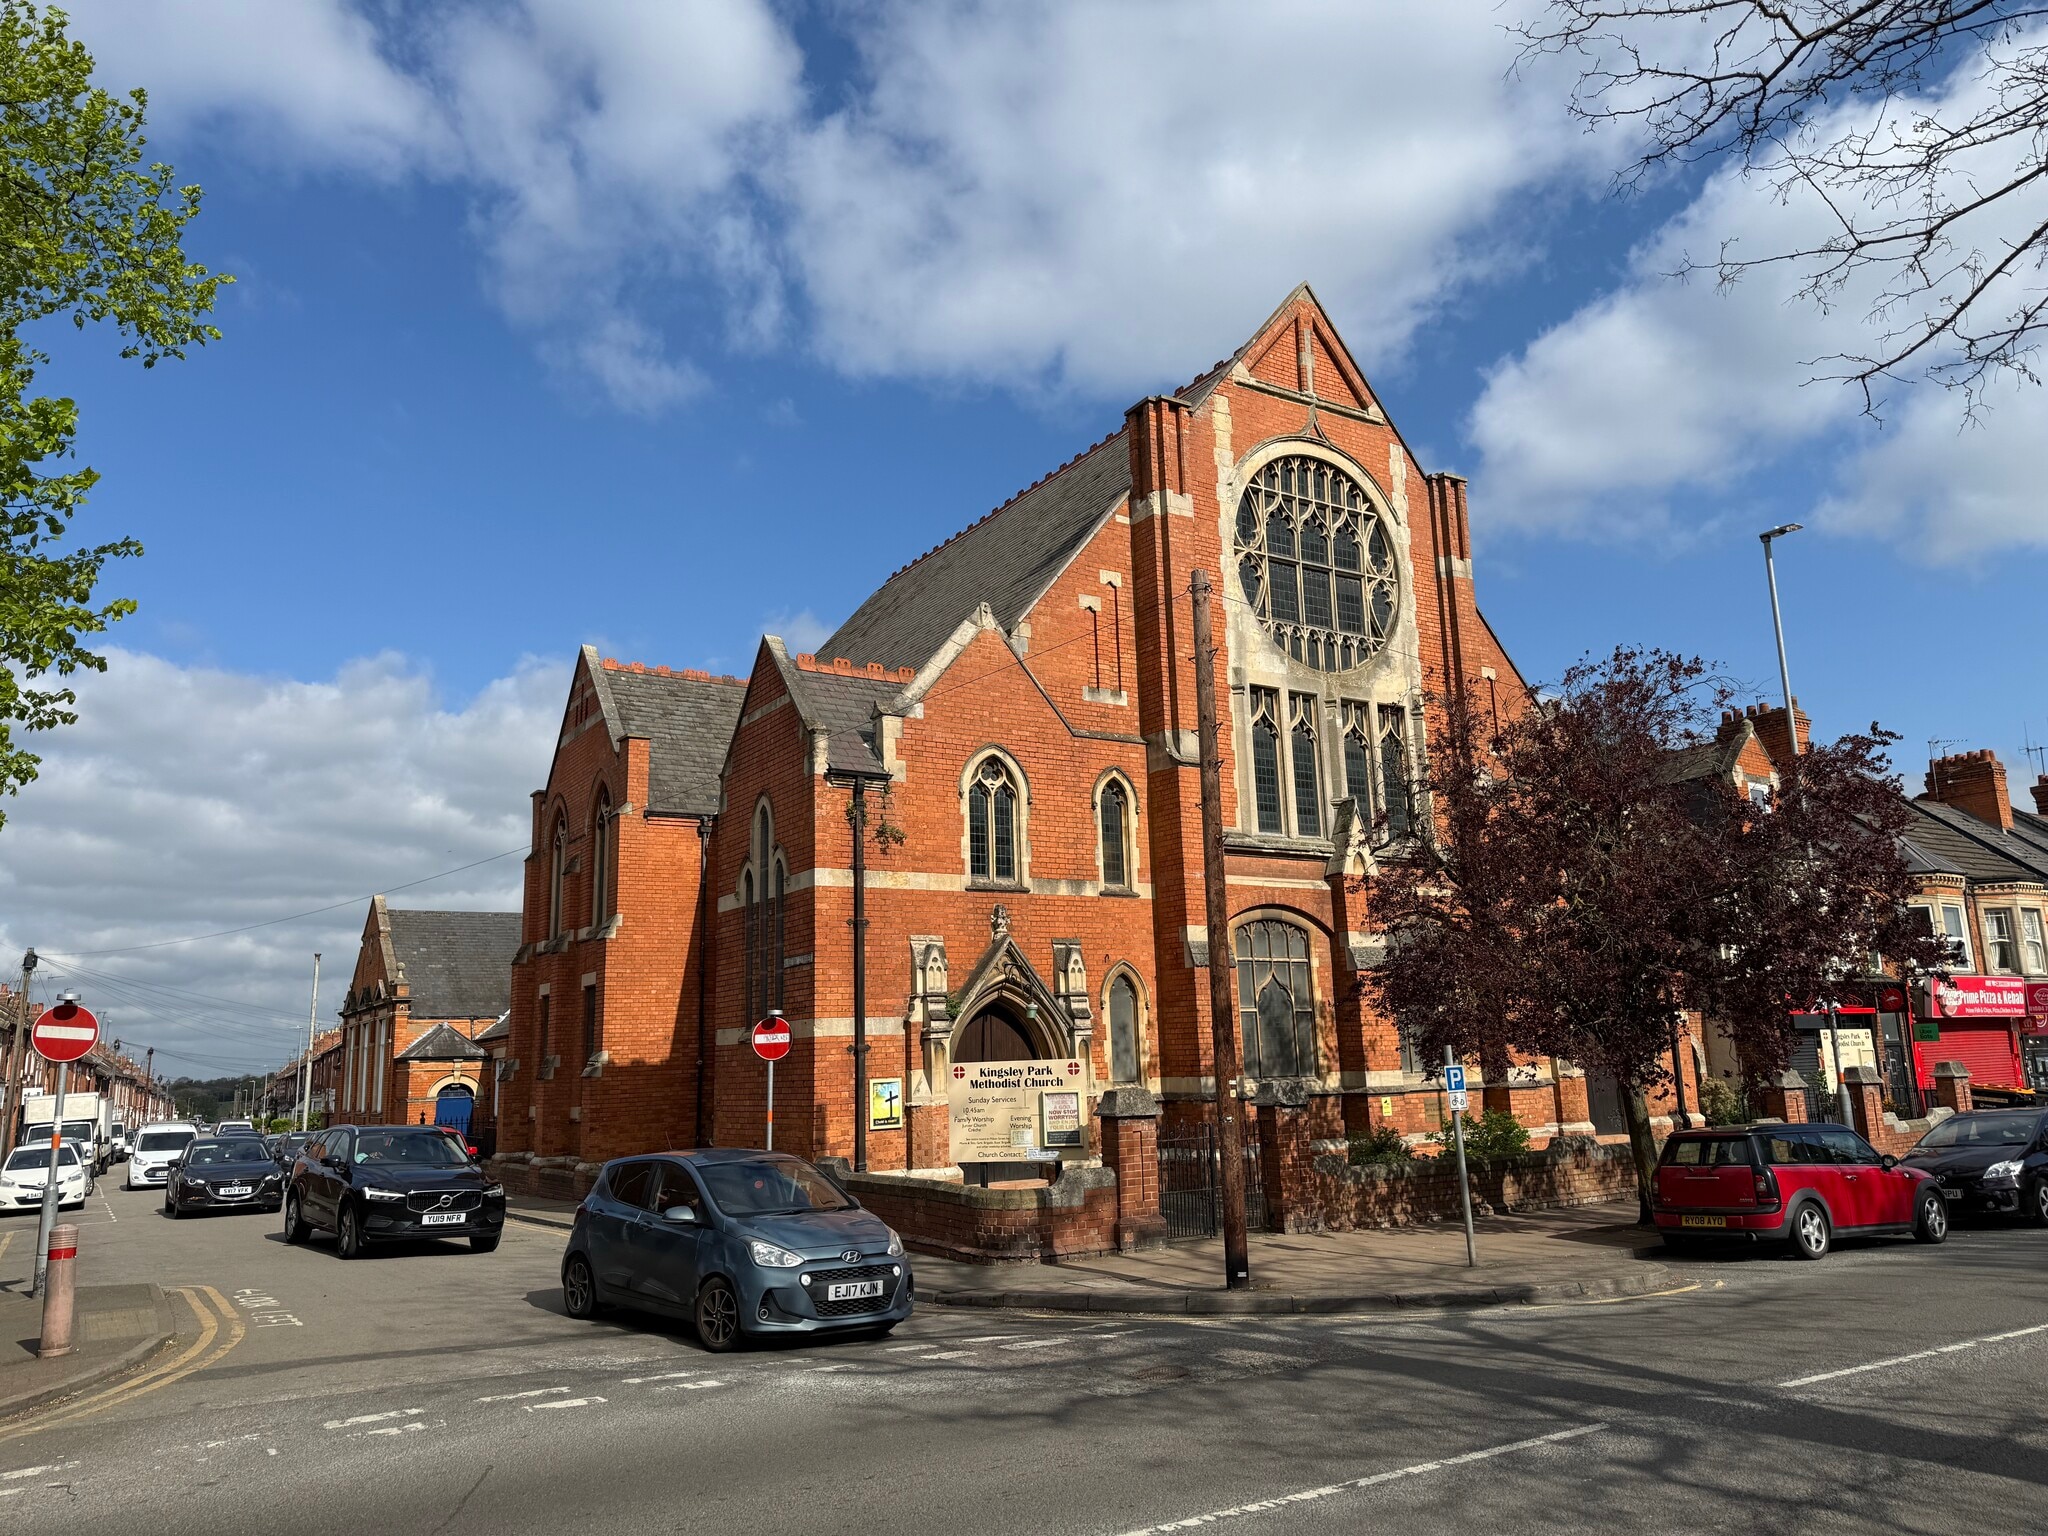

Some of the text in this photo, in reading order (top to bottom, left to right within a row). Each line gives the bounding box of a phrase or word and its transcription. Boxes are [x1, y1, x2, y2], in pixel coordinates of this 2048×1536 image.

[1960, 989, 2024, 1004] Prime Pizza & Kebab
[980, 1066, 1053, 1079] Kingsley Park
[970, 1077, 1063, 1089] Methodist Church
[1450, 1070, 1461, 1088] P
[968, 1096, 990, 1104] Sunday
[428, 1214, 461, 1223] YU19 NFR
[1685, 1216, 1723, 1225] RY08 AYO
[835, 1282, 878, 1298] EJ17 KJN
